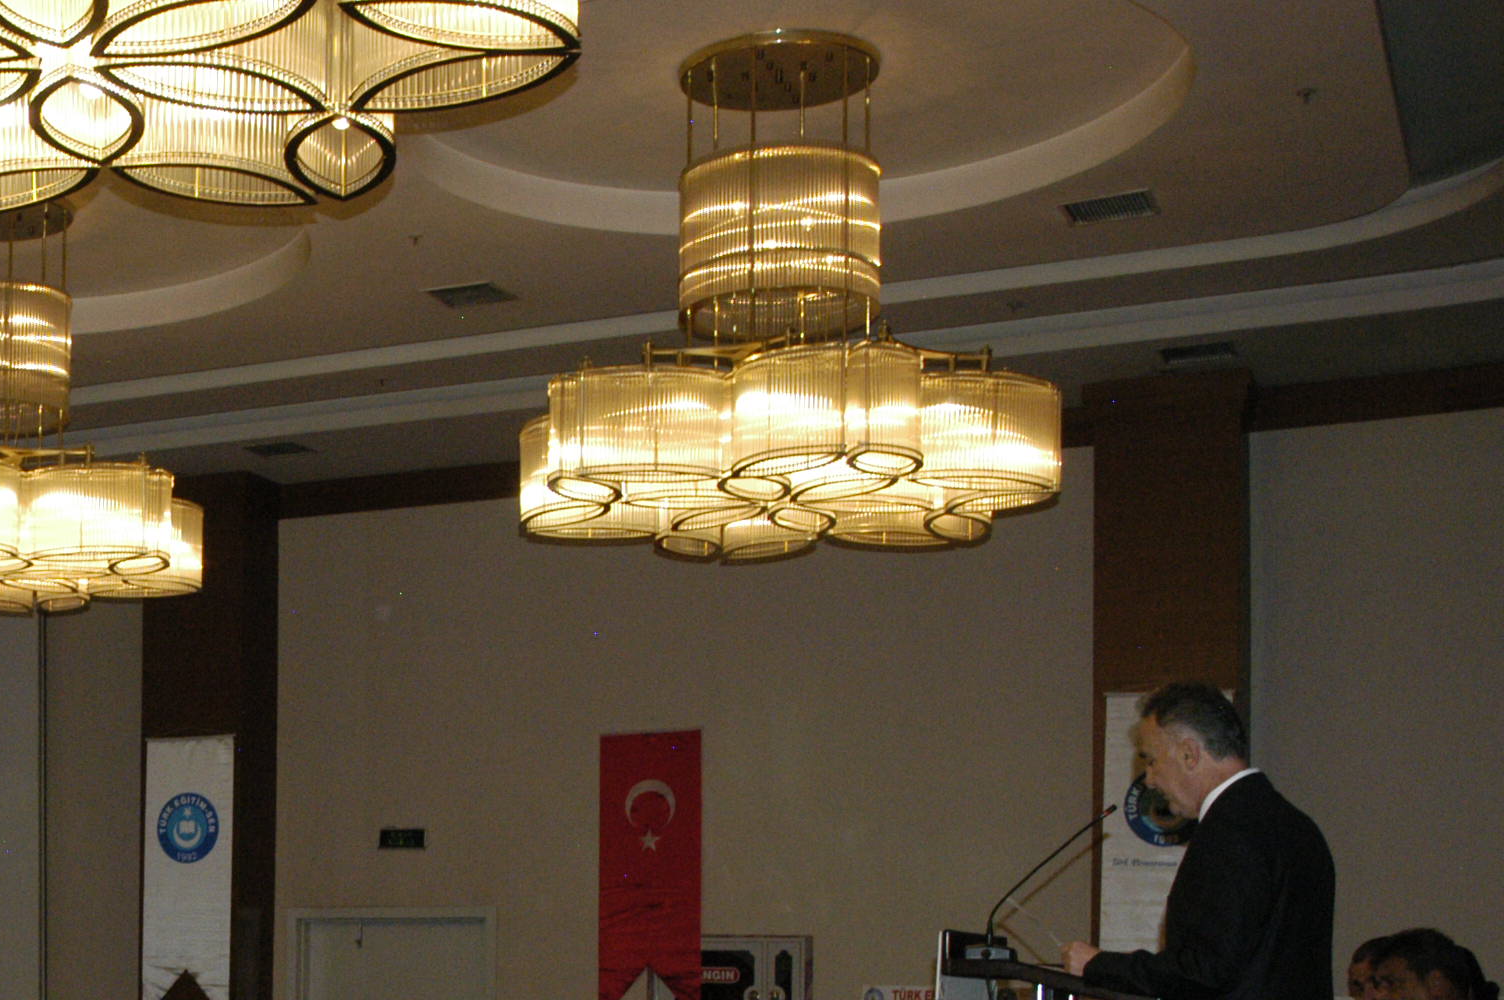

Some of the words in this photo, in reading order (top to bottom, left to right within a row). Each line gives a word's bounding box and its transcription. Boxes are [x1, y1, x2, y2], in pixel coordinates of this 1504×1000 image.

[1126, 786, 1142, 821] TÜRK
[159, 806, 174, 834] TÜRK
[702, 970, 734, 981] NGIN
